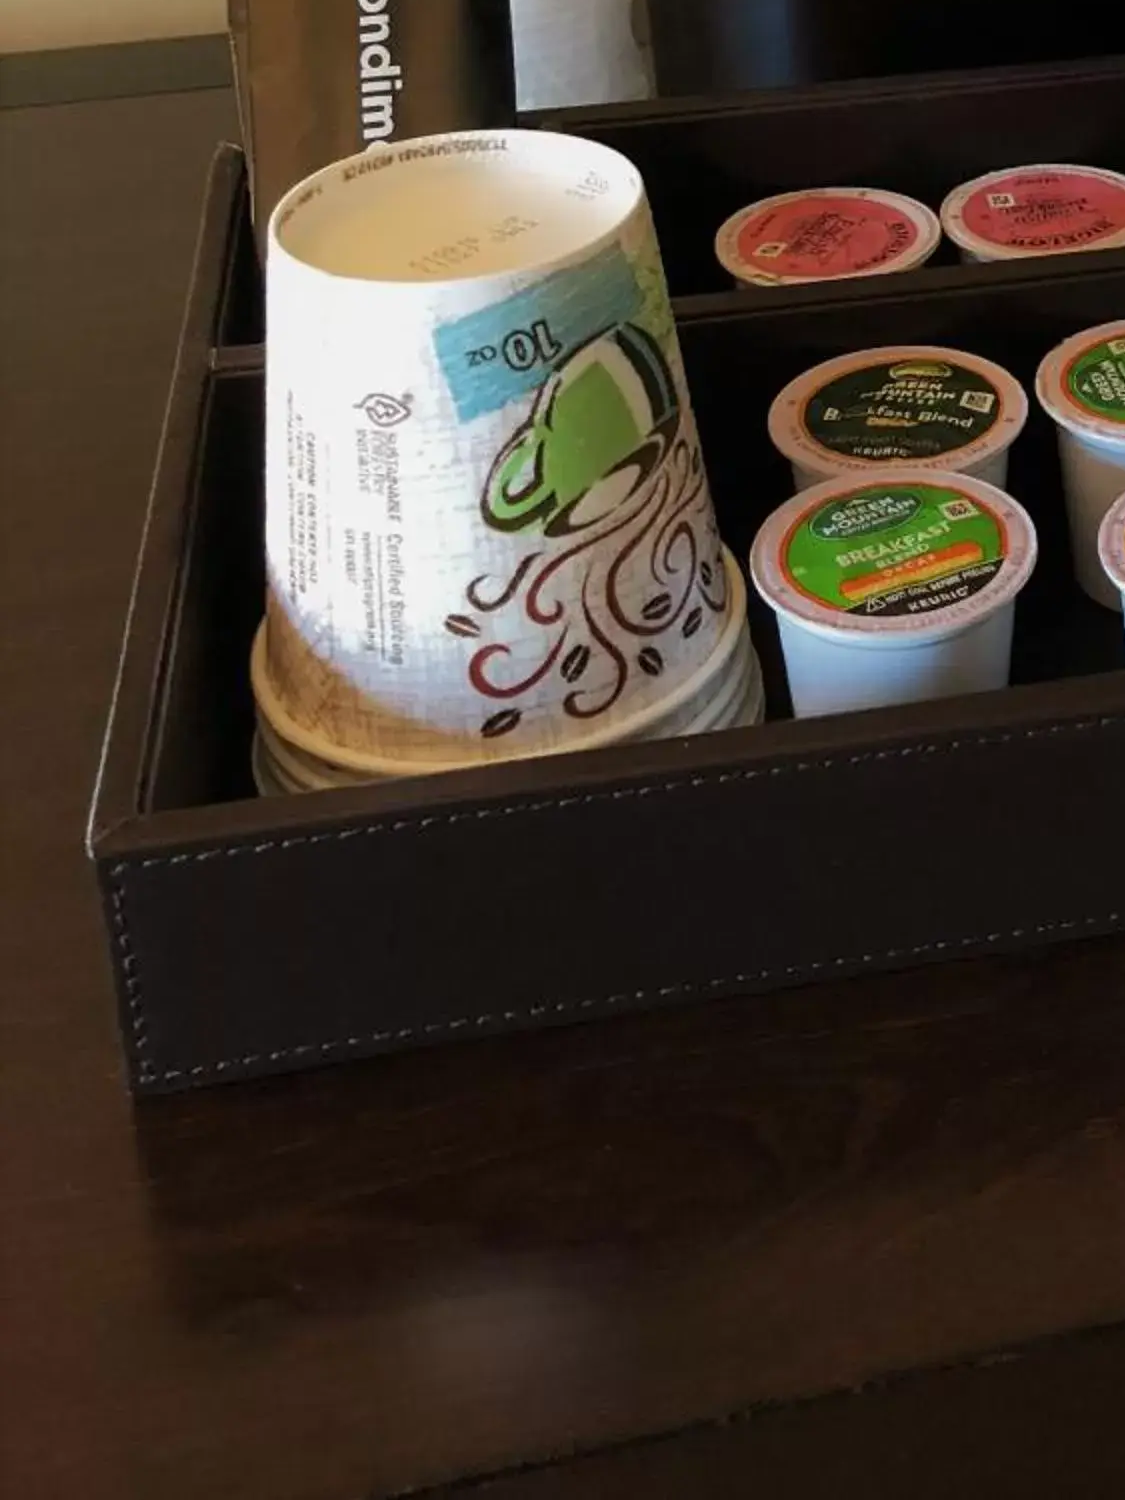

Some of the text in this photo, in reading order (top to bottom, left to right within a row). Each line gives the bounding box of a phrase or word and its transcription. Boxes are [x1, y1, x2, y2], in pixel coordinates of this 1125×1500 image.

[501, 319, 563, 373] 10
[835, 520, 952, 568] BREAKFAST
[385, 533, 407, 666] Certified Sourcing
